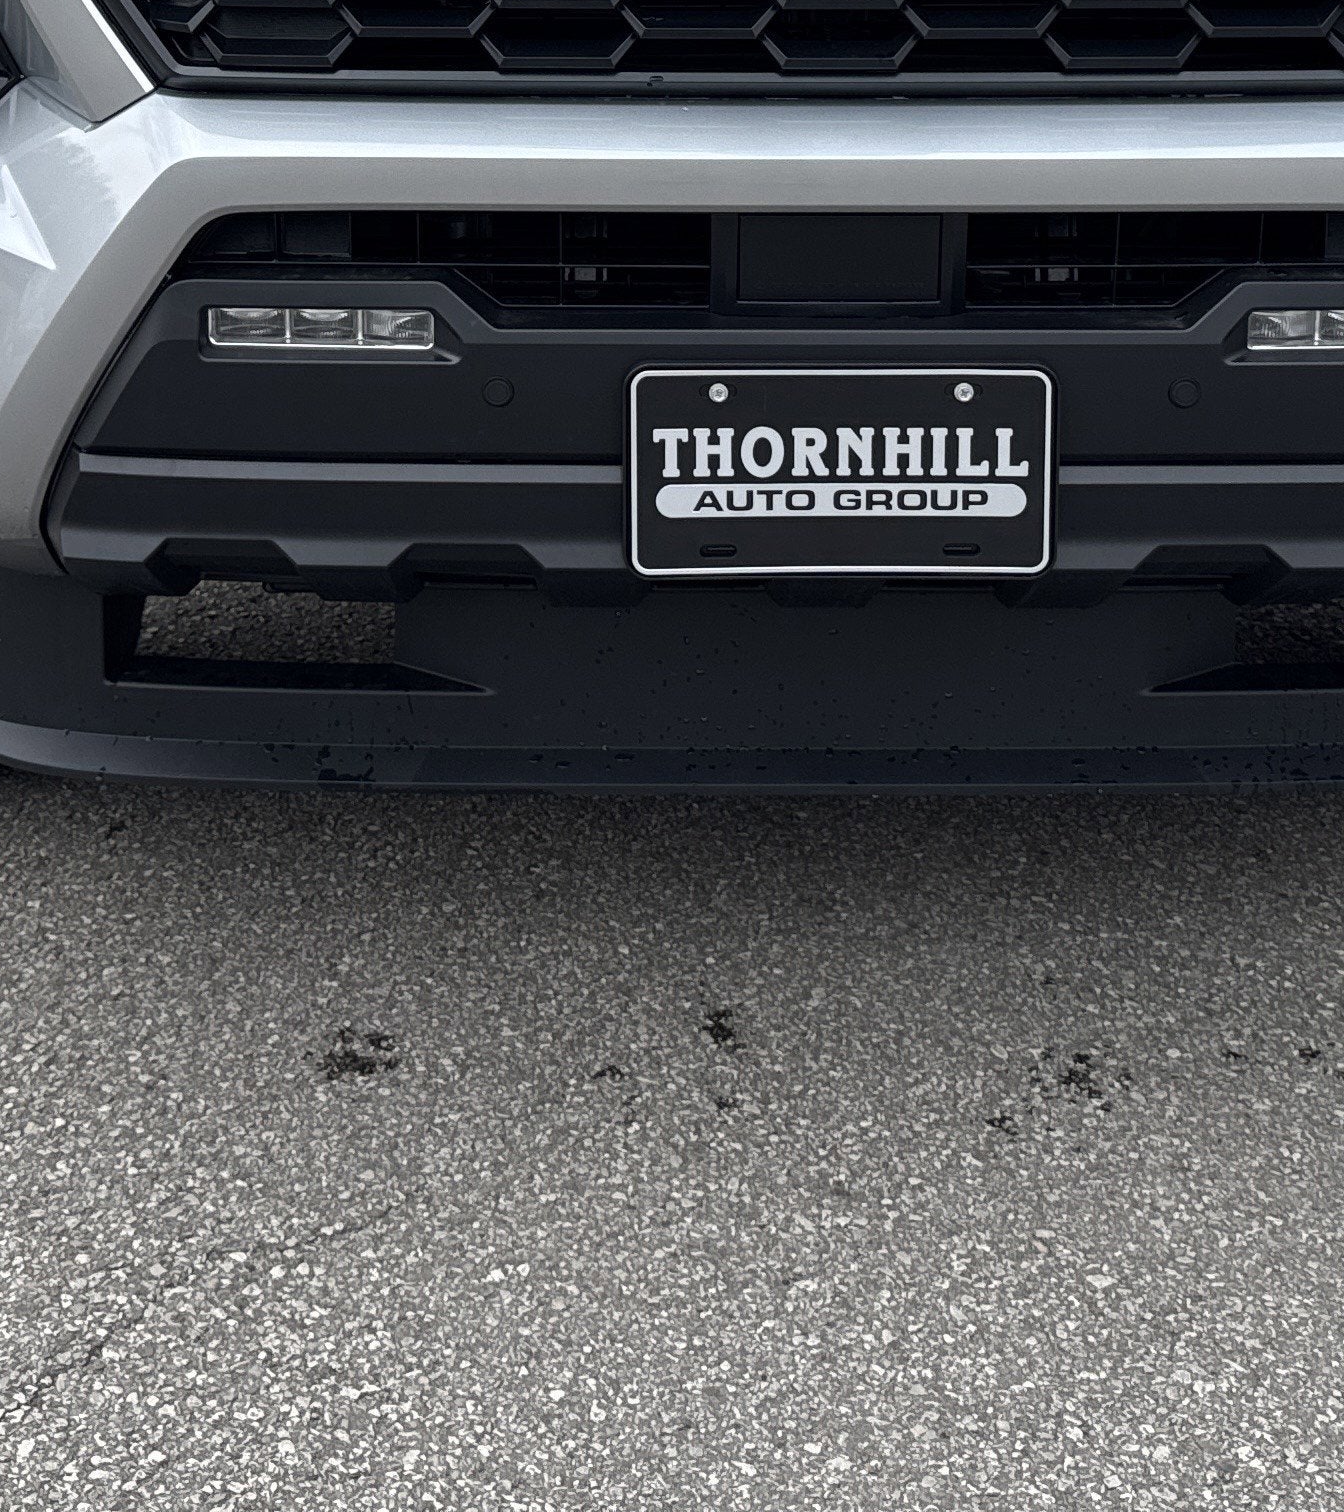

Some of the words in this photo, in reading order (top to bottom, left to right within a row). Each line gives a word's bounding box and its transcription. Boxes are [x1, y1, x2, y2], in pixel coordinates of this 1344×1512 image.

[652, 426, 1029, 478] THORNHILL
[692, 489, 816, 512] AUTO
[832, 489, 989, 512] GROUP
